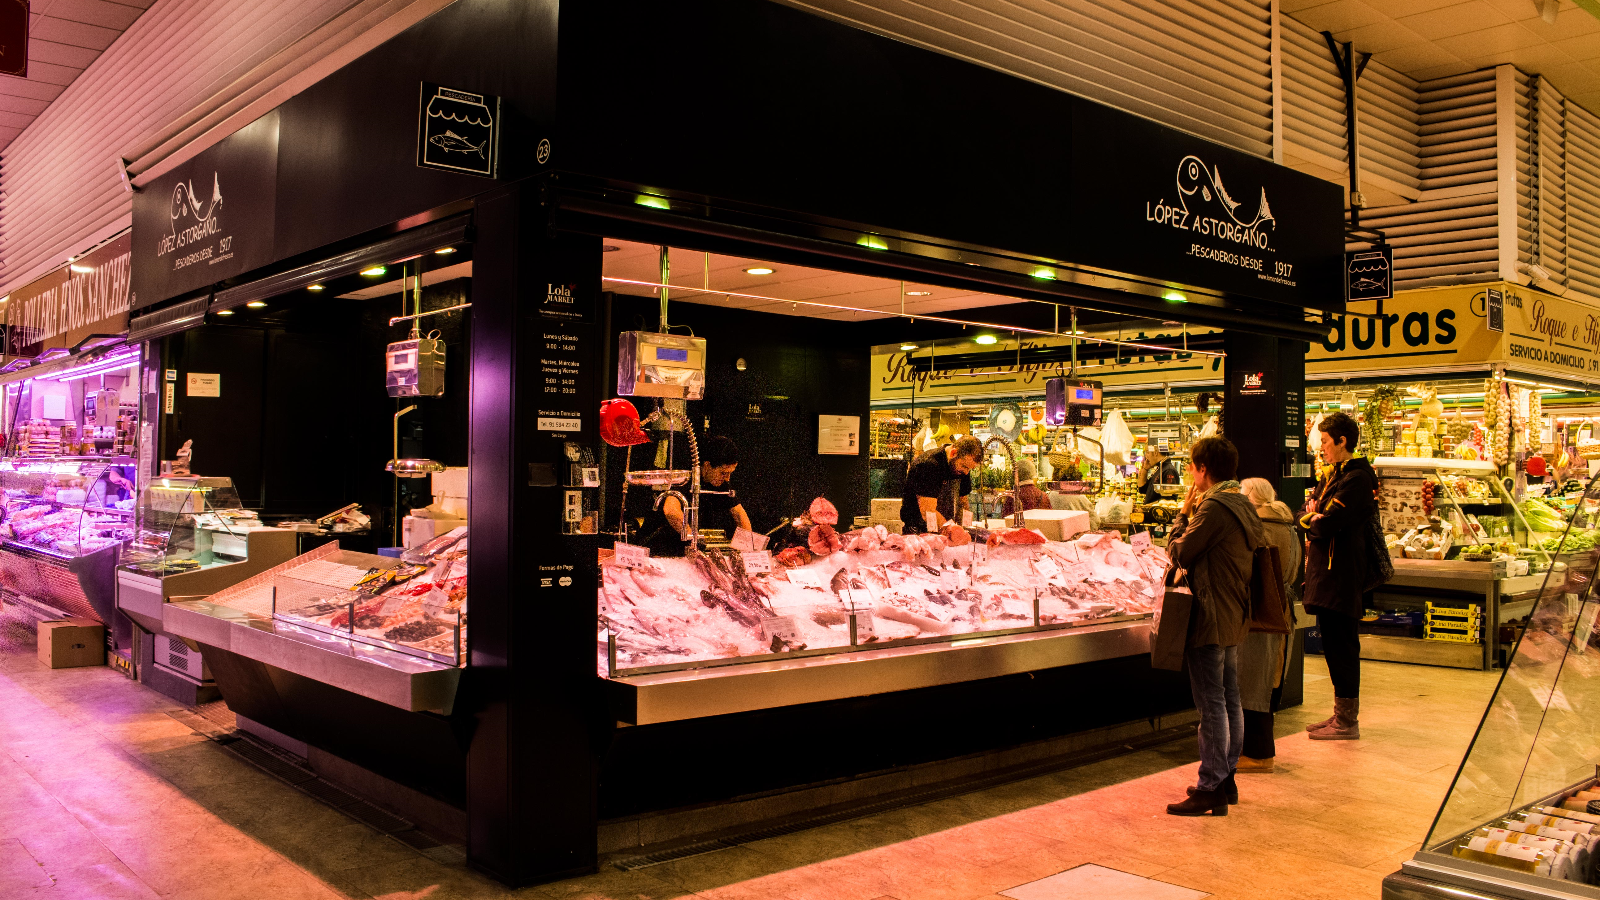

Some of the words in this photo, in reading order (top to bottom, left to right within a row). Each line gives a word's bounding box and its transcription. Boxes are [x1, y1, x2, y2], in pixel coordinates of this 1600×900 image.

[539, 144, 548, 158] 23
[1146, 199, 1189, 230] LÓPEZ
[219, 236, 232, 254] 1917
[1240, 255, 1263, 271] DESDE
[1274, 261, 1293, 277] 1917
[544, 294, 574, 304] MARKET
[547, 283, 571, 297] Lola
[1530, 299, 1567, 347] Roque
[1572, 324, 1579, 341] e
[1509, 343, 1543, 362] SERVICIO
[1544, 350, 1549, 363] A
[1550, 351, 1585, 370] DOMICILIO
[562, 367, 579, 375] Viernes
